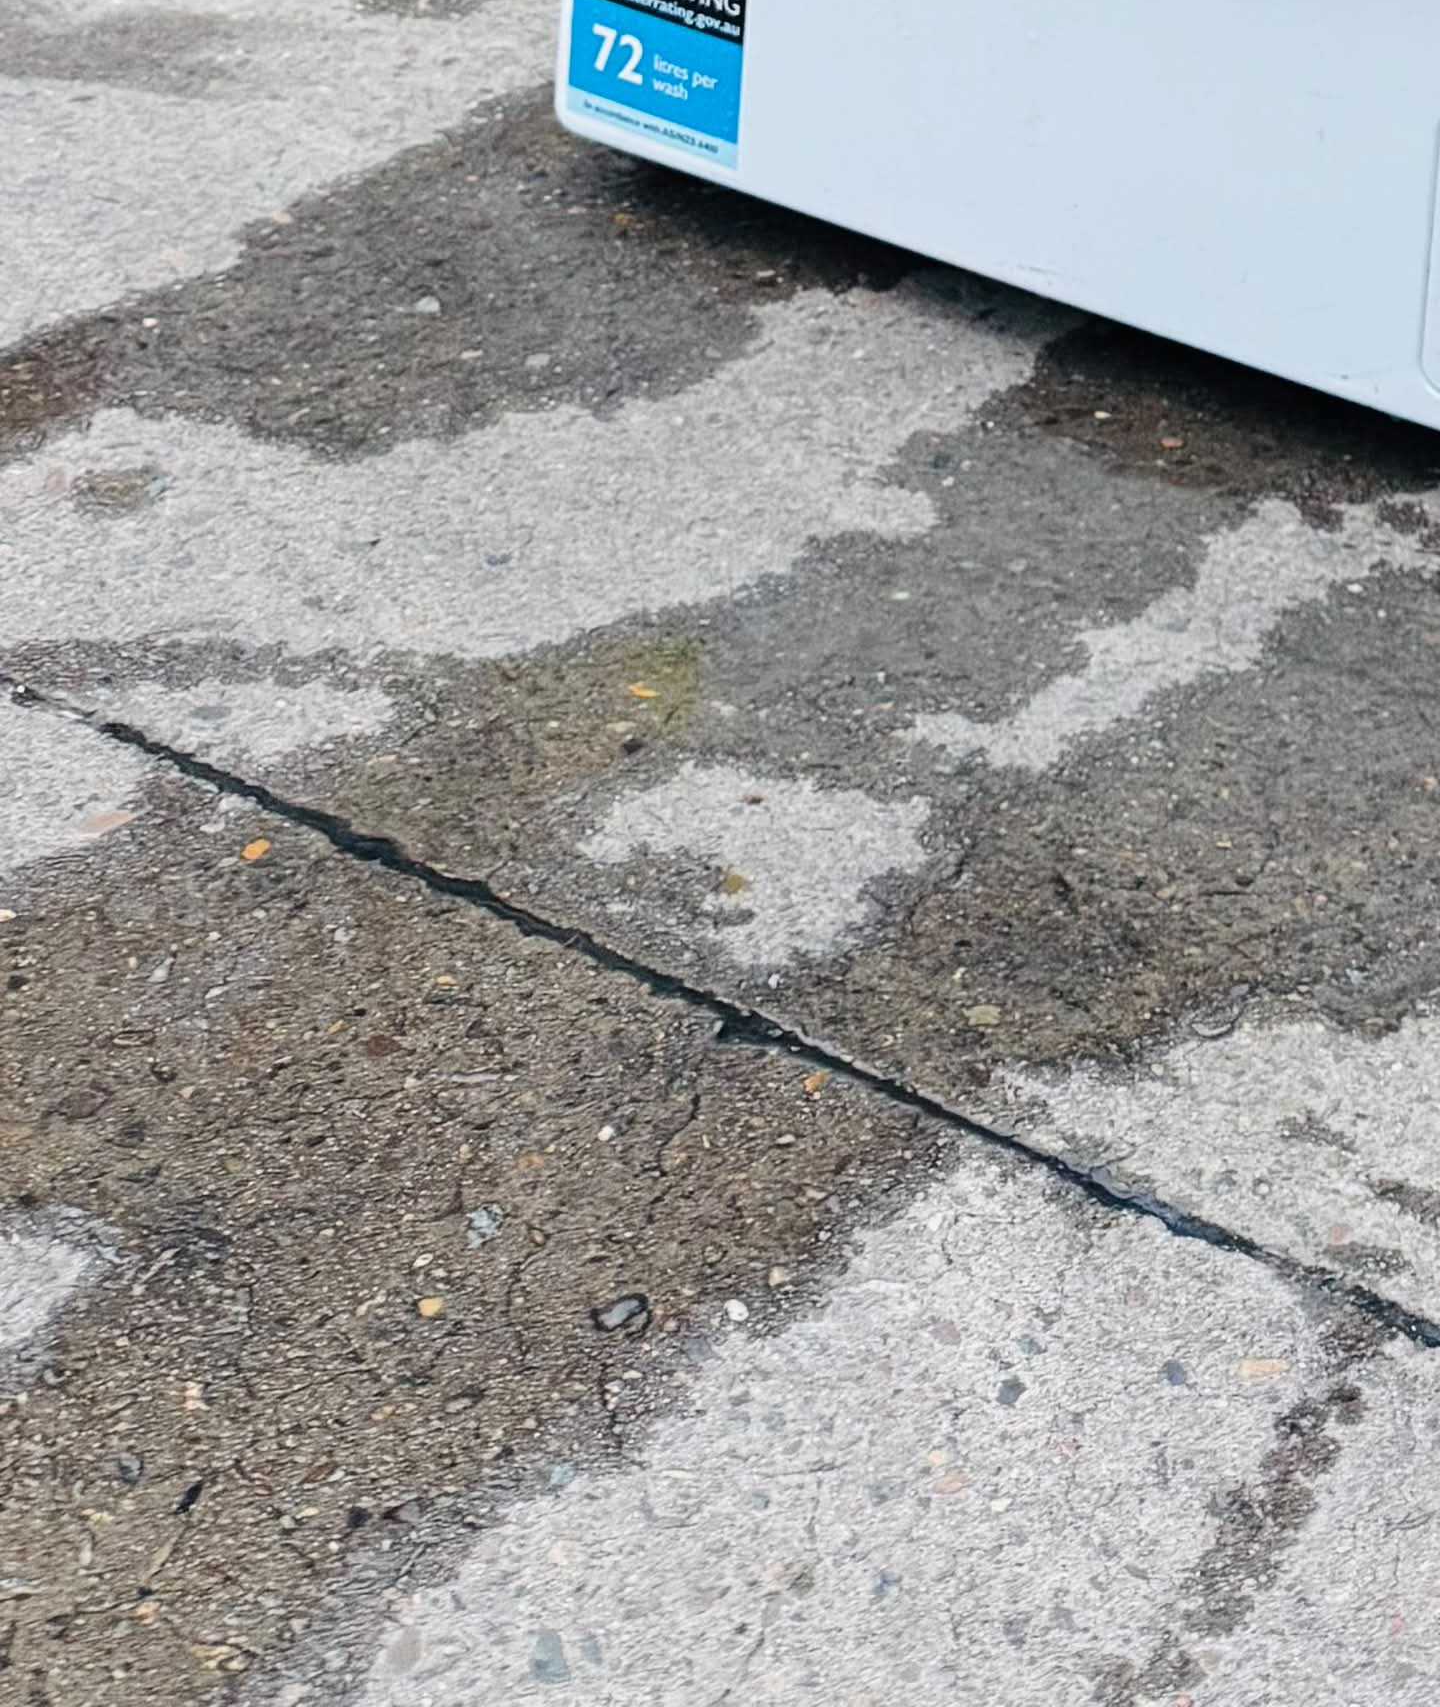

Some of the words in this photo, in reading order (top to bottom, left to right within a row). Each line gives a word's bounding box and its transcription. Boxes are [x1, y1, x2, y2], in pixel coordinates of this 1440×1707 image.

[592, 23, 644, 86] 72
[653, 54, 688, 80] litres
[692, 72, 719, 89] per
[653, 79, 688, 101] wash
